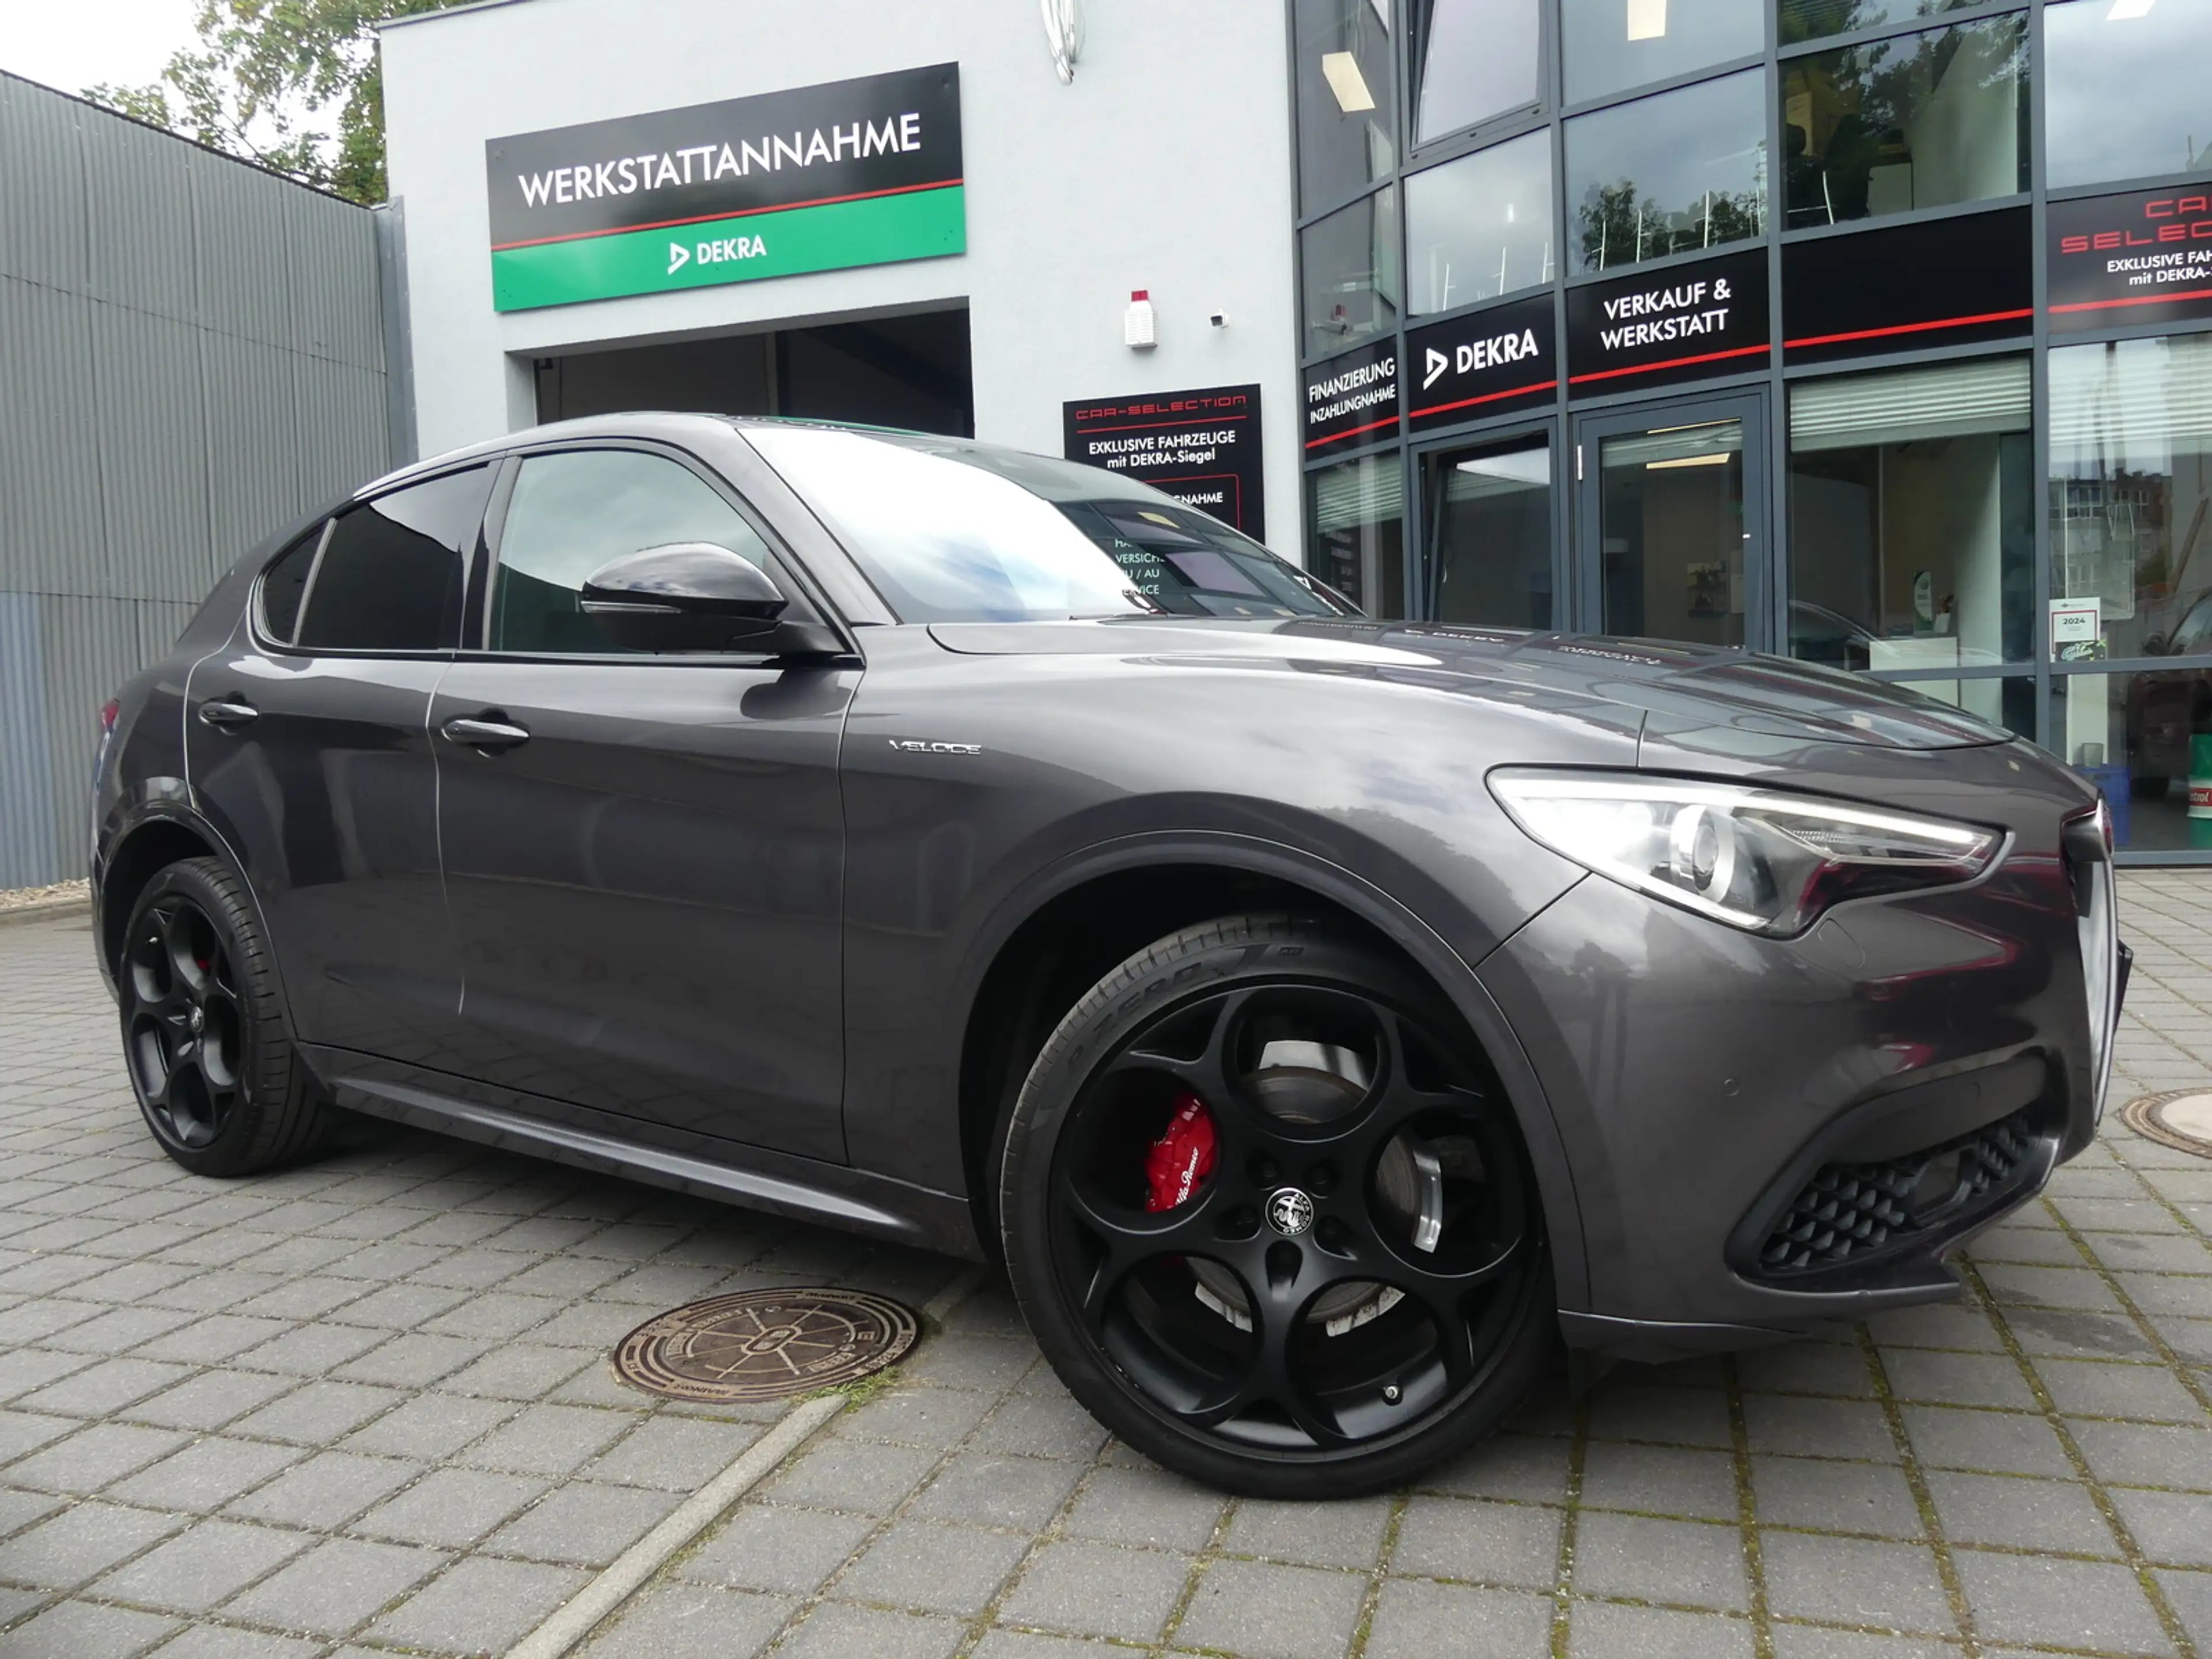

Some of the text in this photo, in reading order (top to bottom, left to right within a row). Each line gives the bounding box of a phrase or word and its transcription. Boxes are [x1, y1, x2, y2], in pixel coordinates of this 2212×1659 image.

[518, 113, 921, 208] WERKSTATTANNAHME
[2146, 196, 2212, 218] CA
[697, 235, 766, 265] DEKRA
[2107, 252, 2184, 273] EXKLUSIVE
[2129, 266, 2212, 285] mit DEKRA-
[1604, 278, 1732, 320] VERKAUF &
[1600, 308, 1729, 350] WERKSTATT
[1456, 328, 1539, 374] DEKRA
[1309, 357, 1396, 403] FINANZIERUNG
[1075, 395, 1247, 420] CAR-SELECTION
[1310, 383, 1396, 424] INZAHLUNGNAHME
[1089, 430, 1236, 455] EXKLUSIVE FAHRZEUGE
[1107, 448, 1215, 468] mit DEKRA-Siegel
[1144, 569, 1160, 578] AU
[2062, 617, 2086, 625] 2024
[889, 739, 982, 755] VELOCE
